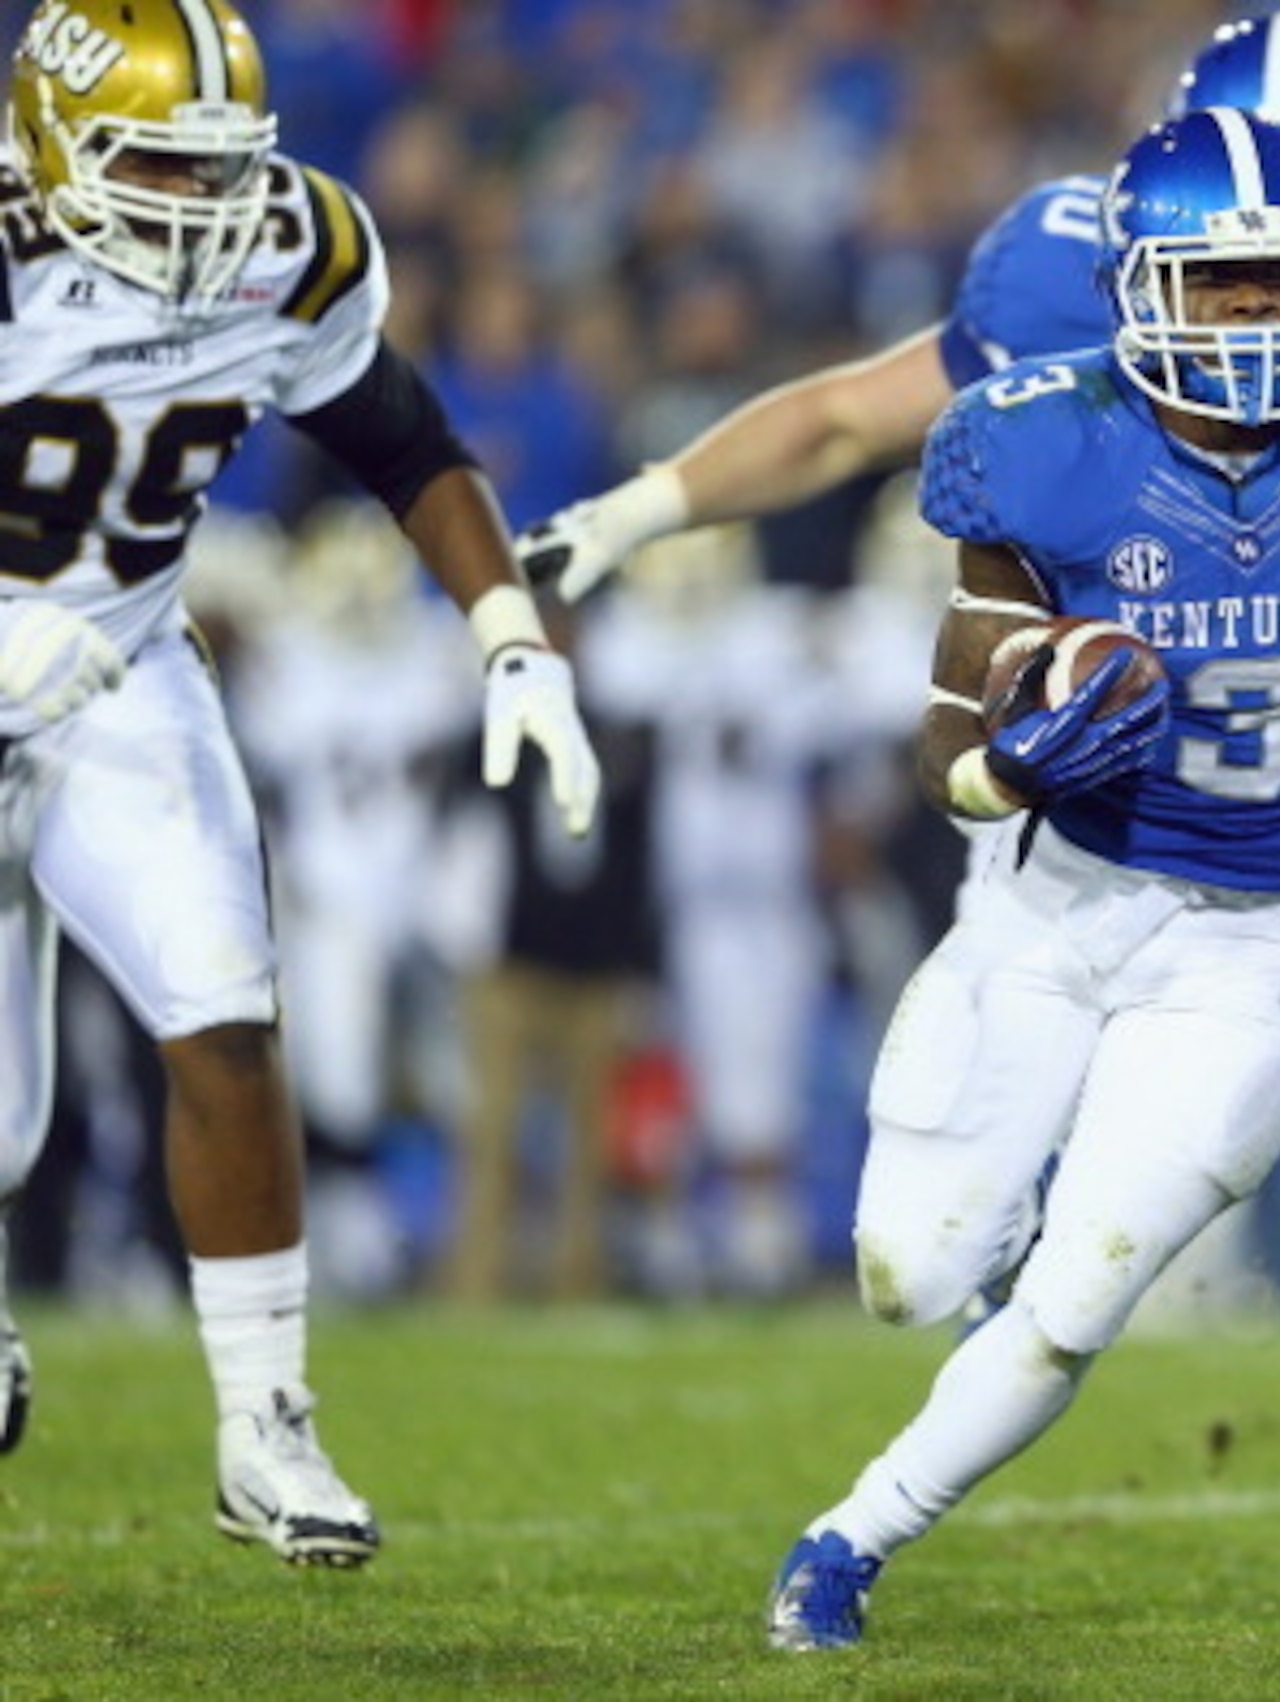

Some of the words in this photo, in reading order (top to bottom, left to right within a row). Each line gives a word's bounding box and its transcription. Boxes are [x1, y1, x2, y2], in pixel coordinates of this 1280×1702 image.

[984, 364, 1078, 410] 3
[0, 396, 250, 588] 99
[1111, 541, 1167, 592] SEC
